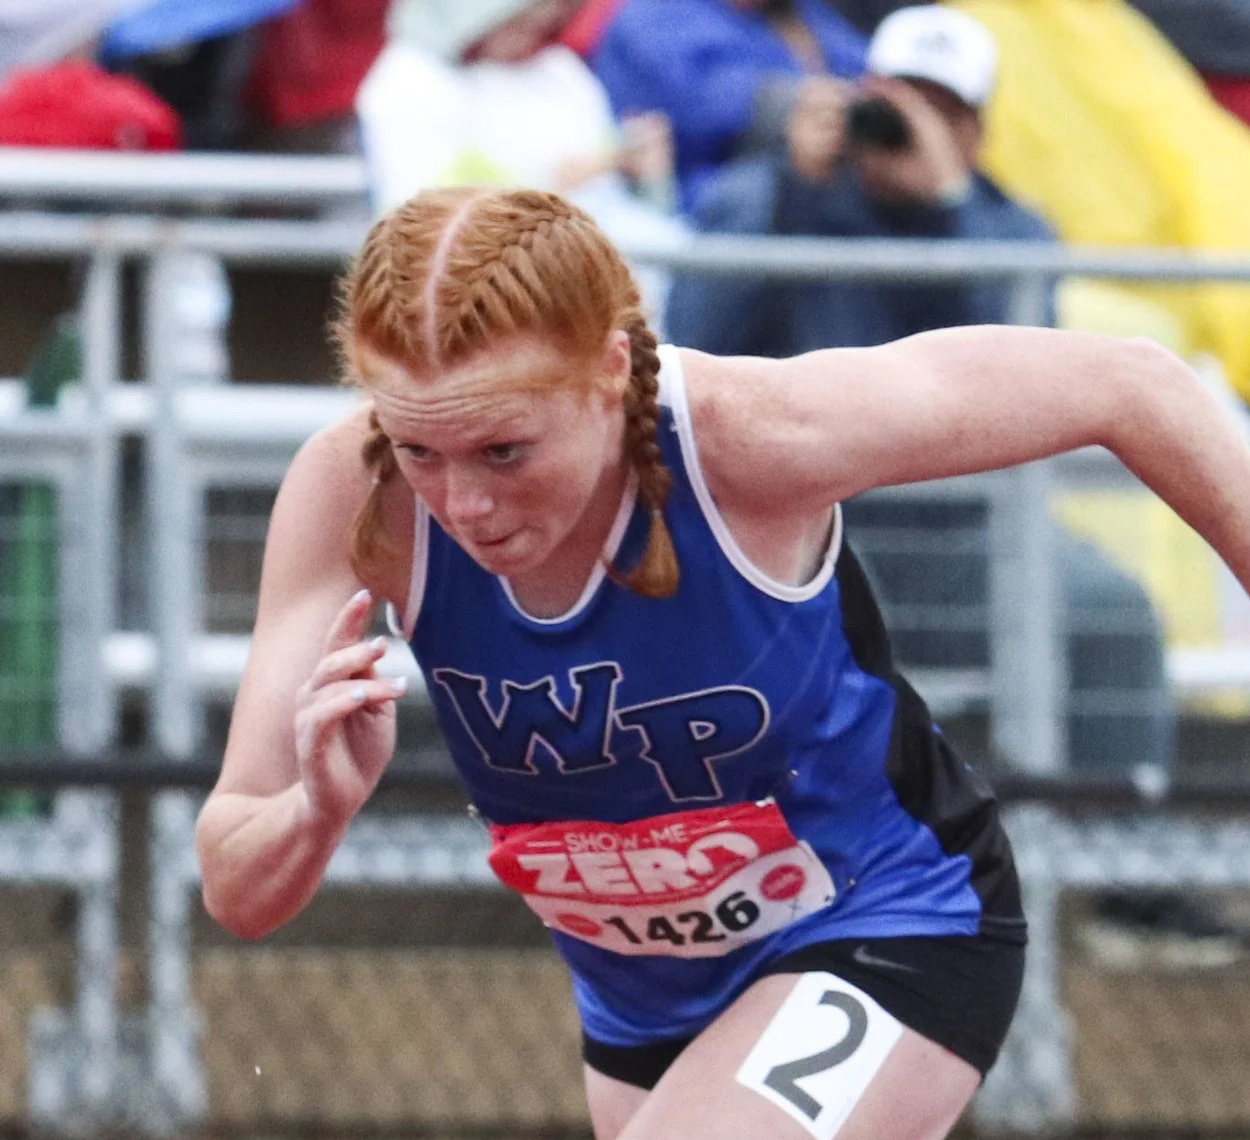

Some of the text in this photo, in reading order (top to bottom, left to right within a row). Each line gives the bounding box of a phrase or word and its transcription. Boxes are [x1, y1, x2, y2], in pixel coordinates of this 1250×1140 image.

[433, 661, 770, 801] WP
[517, 832, 759, 897] ZERO
[604, 891, 760, 946] 1426
[763, 989, 868, 1122] 2
